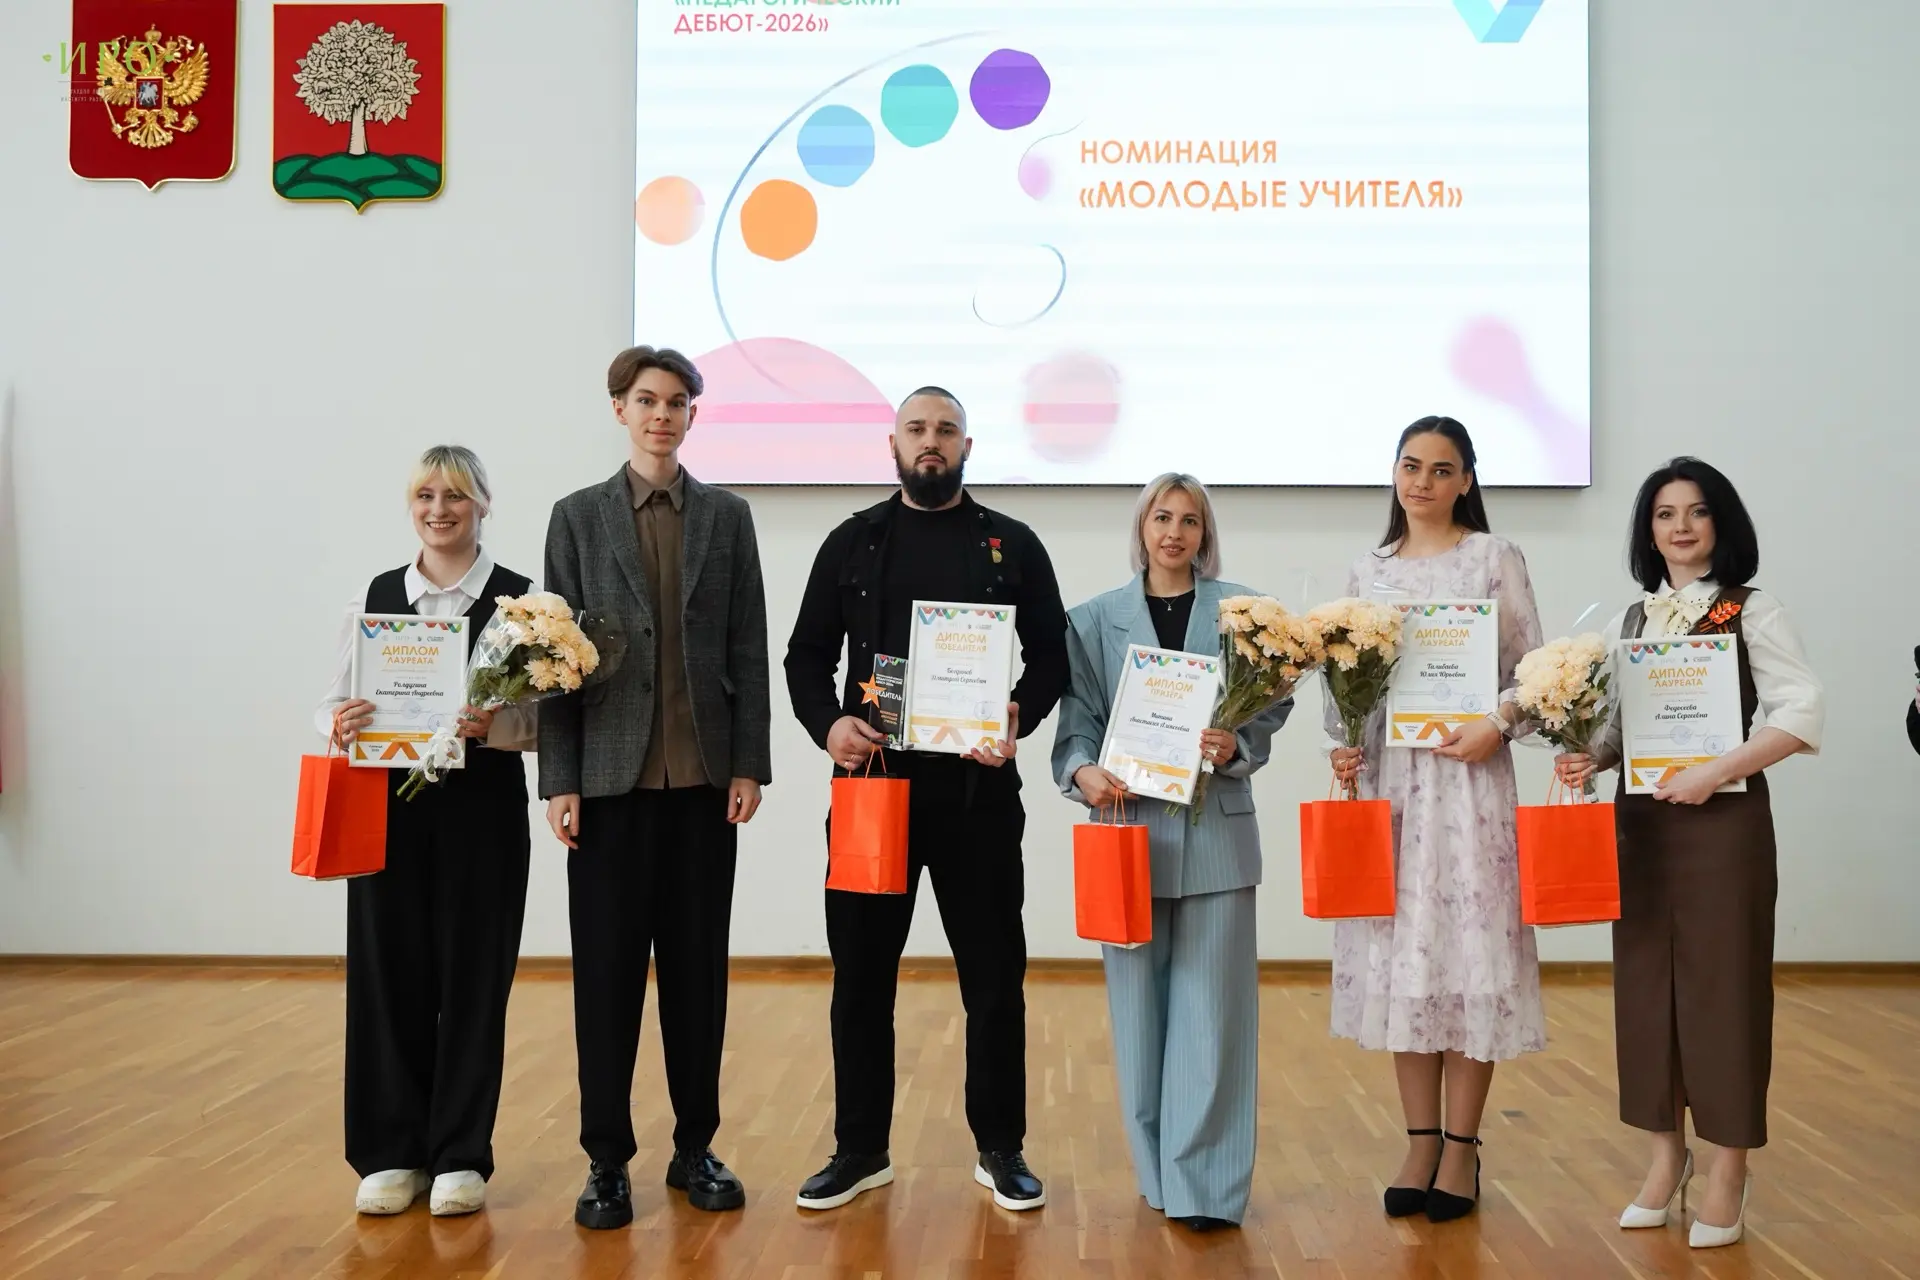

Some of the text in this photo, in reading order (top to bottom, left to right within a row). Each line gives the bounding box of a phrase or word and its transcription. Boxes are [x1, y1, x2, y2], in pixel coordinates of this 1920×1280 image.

[674, 13, 829, 34] ДЕБЮТ-2026»
[1080, 140, 1277, 167] НОМИНАЦИЯ
[1079, 180, 1463, 211] «МОЛОДЫЕ УЧИТЕЛЯ»
[936, 631, 987, 643] ДИПЛОМ
[1415, 628, 1470, 639] ДИПЛОМ
[935, 642, 987, 652] ПОБЕДИТЕЛЯ
[1419, 639, 1465, 647] ЛАУРЕАТА
[382, 645, 439, 656] ДИПЛОМ
[387, 656, 434, 665] ЛАУРЕАТА
[1648, 667, 1708, 681] ДИПЛОМ
[1145, 677, 1194, 693] ДИПЛОМ
[1654, 678, 1704, 688] ЛАУРЕАТА
[375, 688, 444, 697] Екатерина Андреевна
[865, 687, 902, 701] ПОБЕДИТЕЛЬ
[1150, 688, 1184, 700] ПРИЗЕРА
[1655, 712, 1708, 721] Алина Сергеевна
